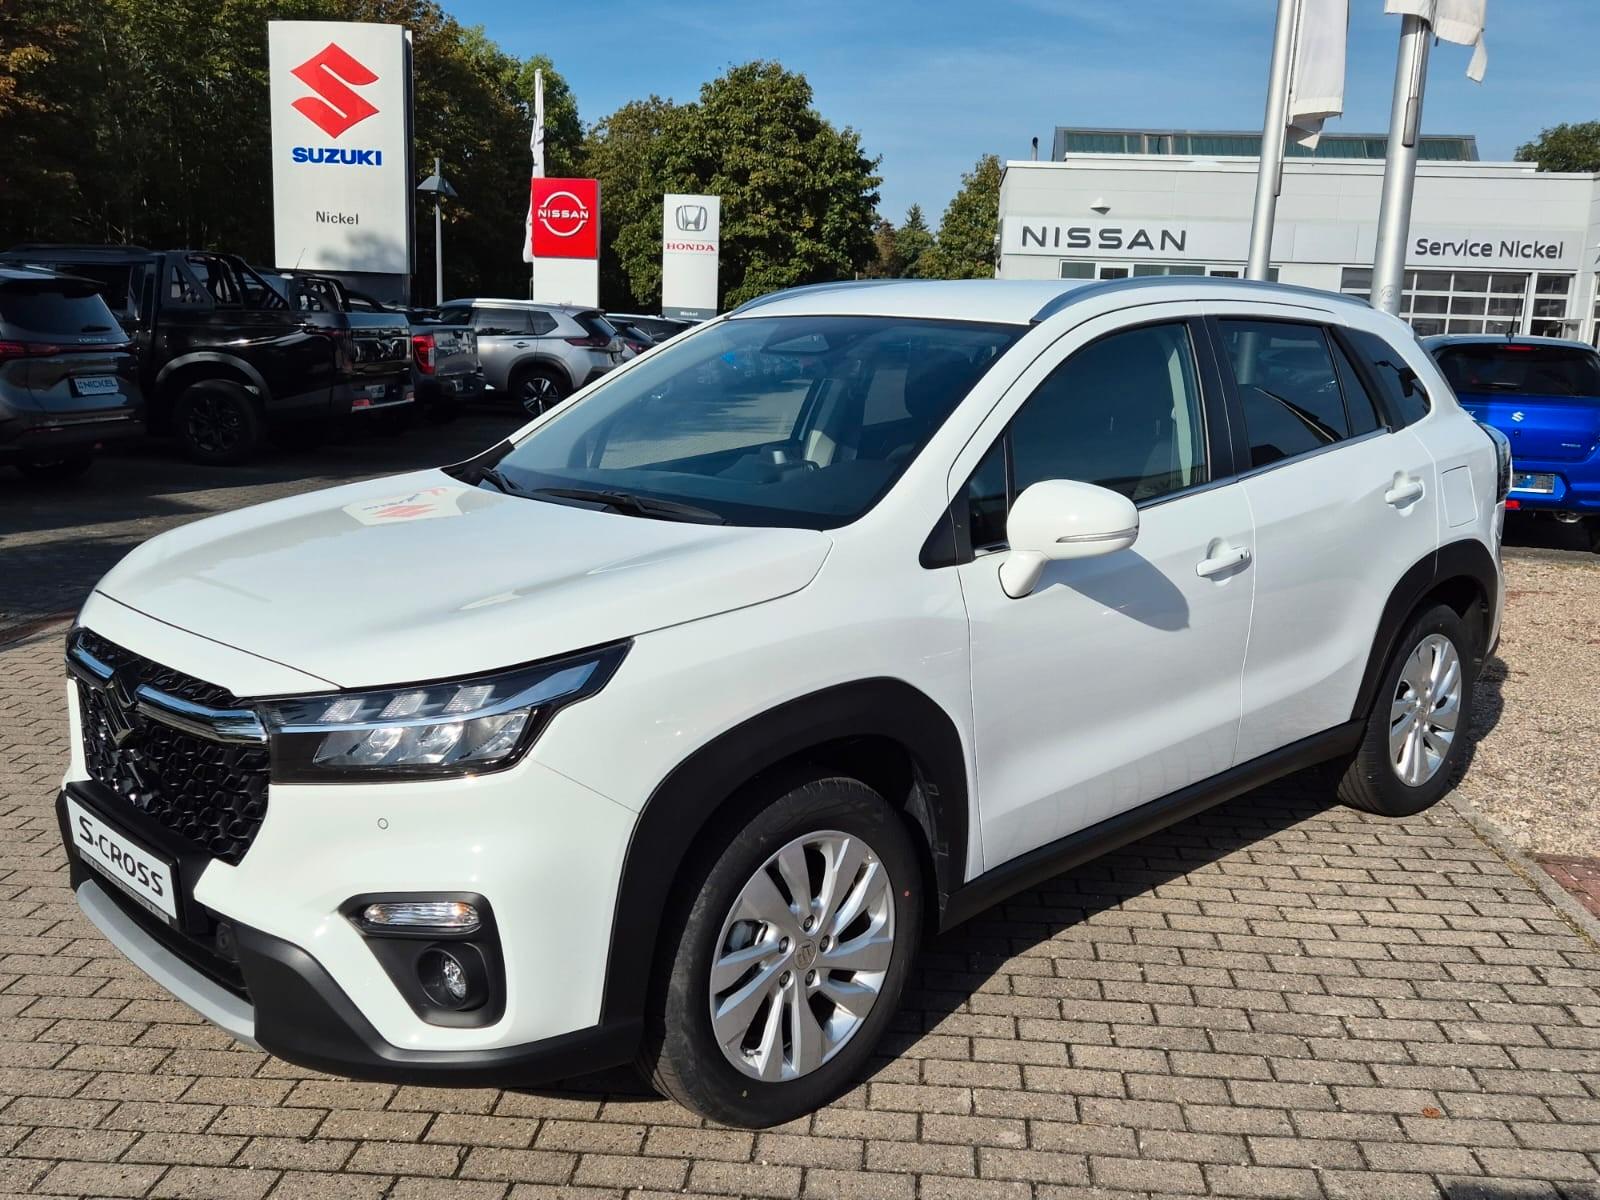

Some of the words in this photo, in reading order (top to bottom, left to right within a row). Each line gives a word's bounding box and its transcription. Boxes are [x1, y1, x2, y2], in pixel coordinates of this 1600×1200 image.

[292, 147, 382, 166] SUZUKI
[315, 211, 359, 225] Nickel
[538, 208, 589, 219] NISSAN
[1021, 225, 1186, 251] NISSAN
[666, 242, 716, 252] HONDA
[1415, 238, 1493, 257] Service
[1499, 240, 1564, 259] Nickel
